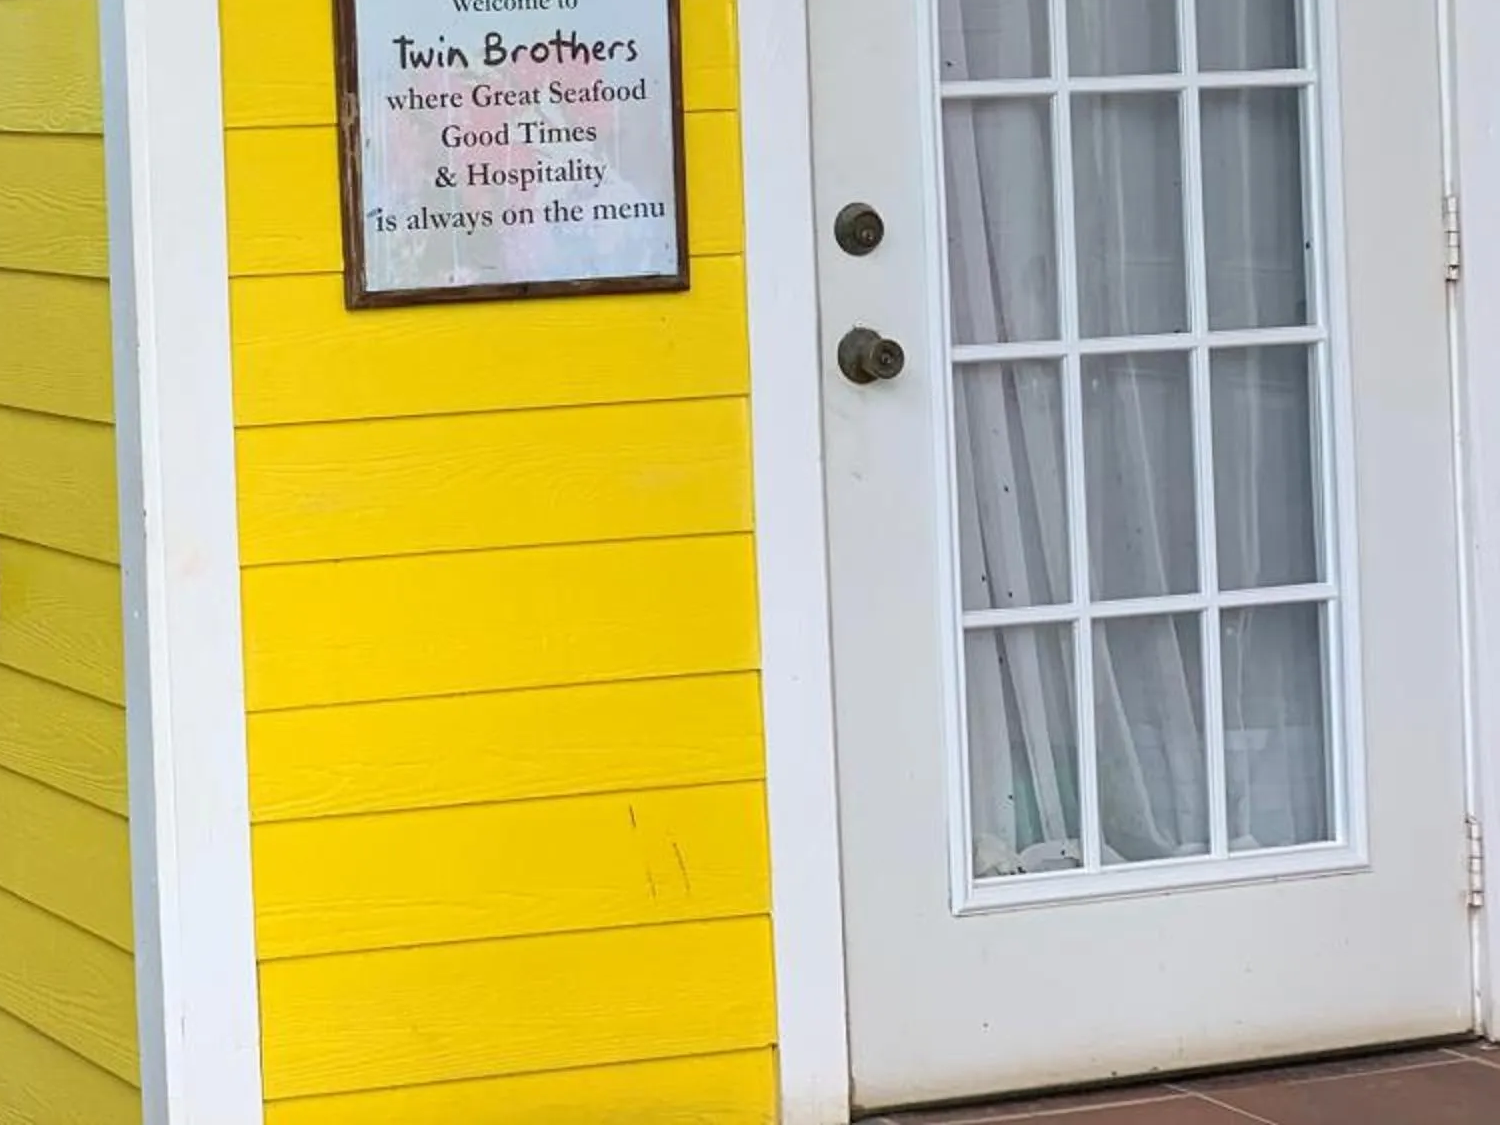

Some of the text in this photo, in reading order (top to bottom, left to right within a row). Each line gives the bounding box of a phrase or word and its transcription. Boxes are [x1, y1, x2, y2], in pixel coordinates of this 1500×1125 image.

[392, 28, 640, 71] Twin Brothers
[387, 78, 647, 111] where Great Seafood
[441, 121, 598, 149] Good Times
[435, 158, 608, 191] & Hospitality
[375, 200, 666, 235] is always on the menu
